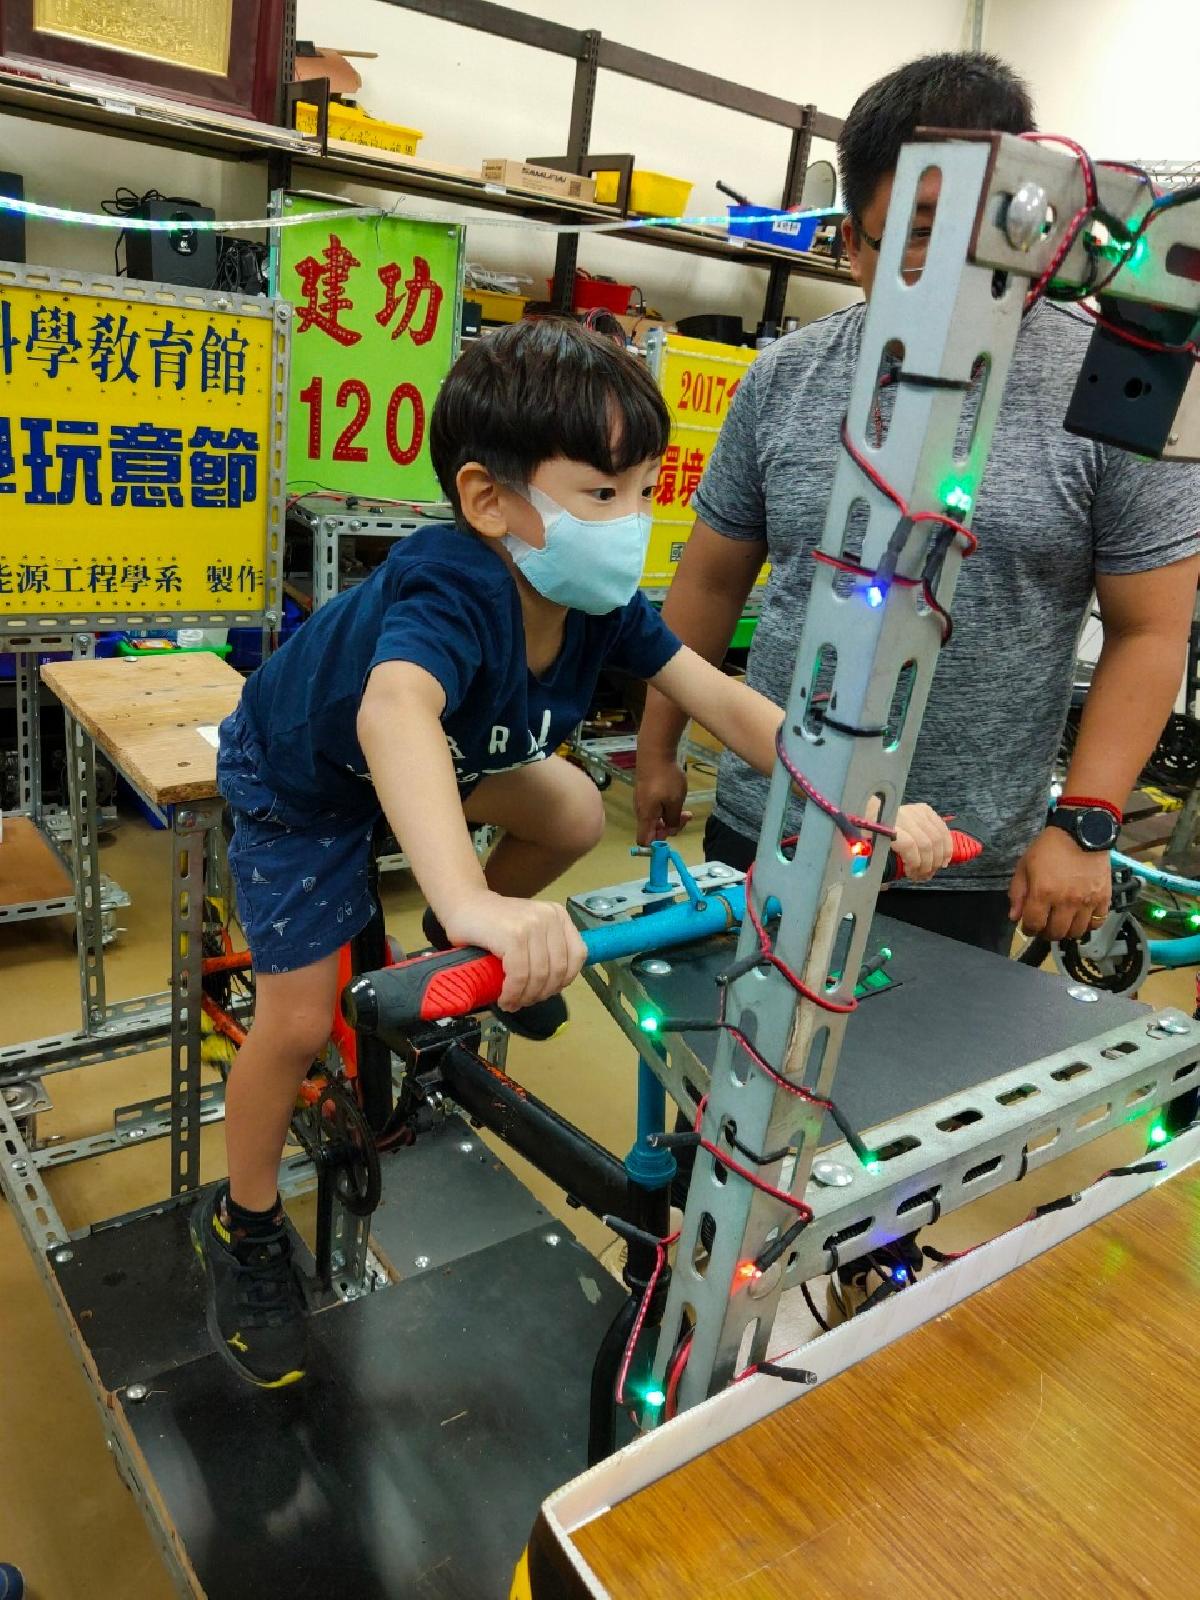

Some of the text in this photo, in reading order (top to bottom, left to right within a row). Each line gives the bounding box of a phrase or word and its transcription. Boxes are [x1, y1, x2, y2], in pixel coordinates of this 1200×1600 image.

[294, 233, 444, 347] 建功
[0, 416, 260, 508] 玩意節
[299, 376, 425, 466] 120
[207, 564, 264, 593] 製作
